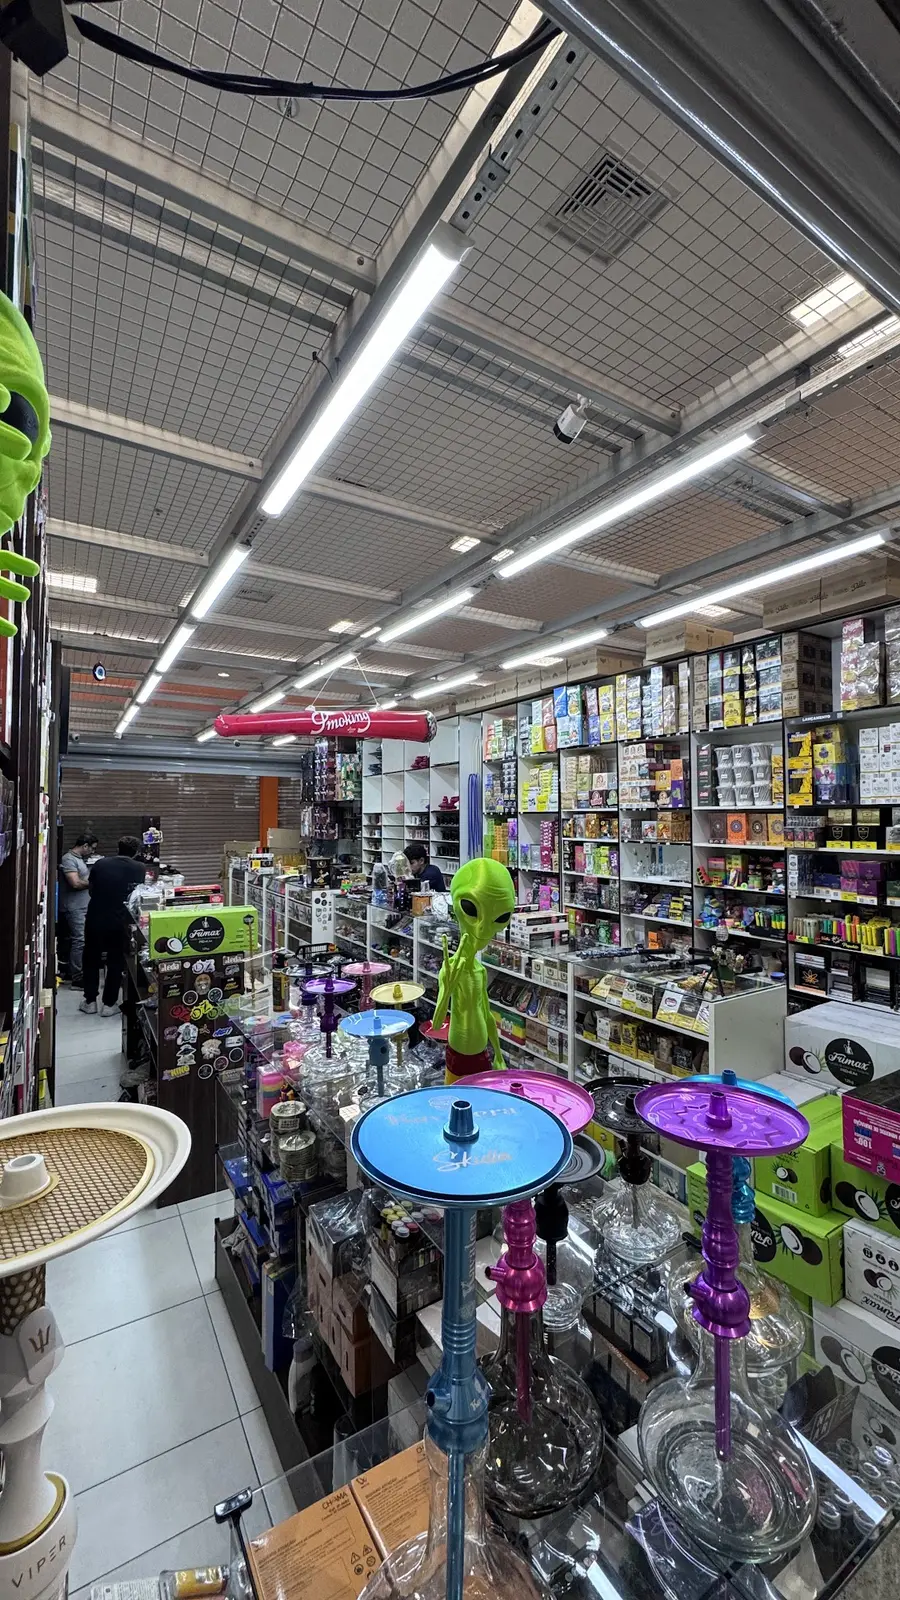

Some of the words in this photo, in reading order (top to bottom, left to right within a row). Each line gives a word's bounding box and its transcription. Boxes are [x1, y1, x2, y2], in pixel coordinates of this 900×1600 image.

[310, 711, 371, 734] Smoking
[802, 714, 831, 722] LANÇAMENTO
[189, 928, 222, 939] Fumax
[828, 1052, 871, 1071] Fumax
[170, 1065, 190, 1077] KING
[854, 1137, 872, 1149] 100%
[11, 1535, 67, 1588] VIPER
